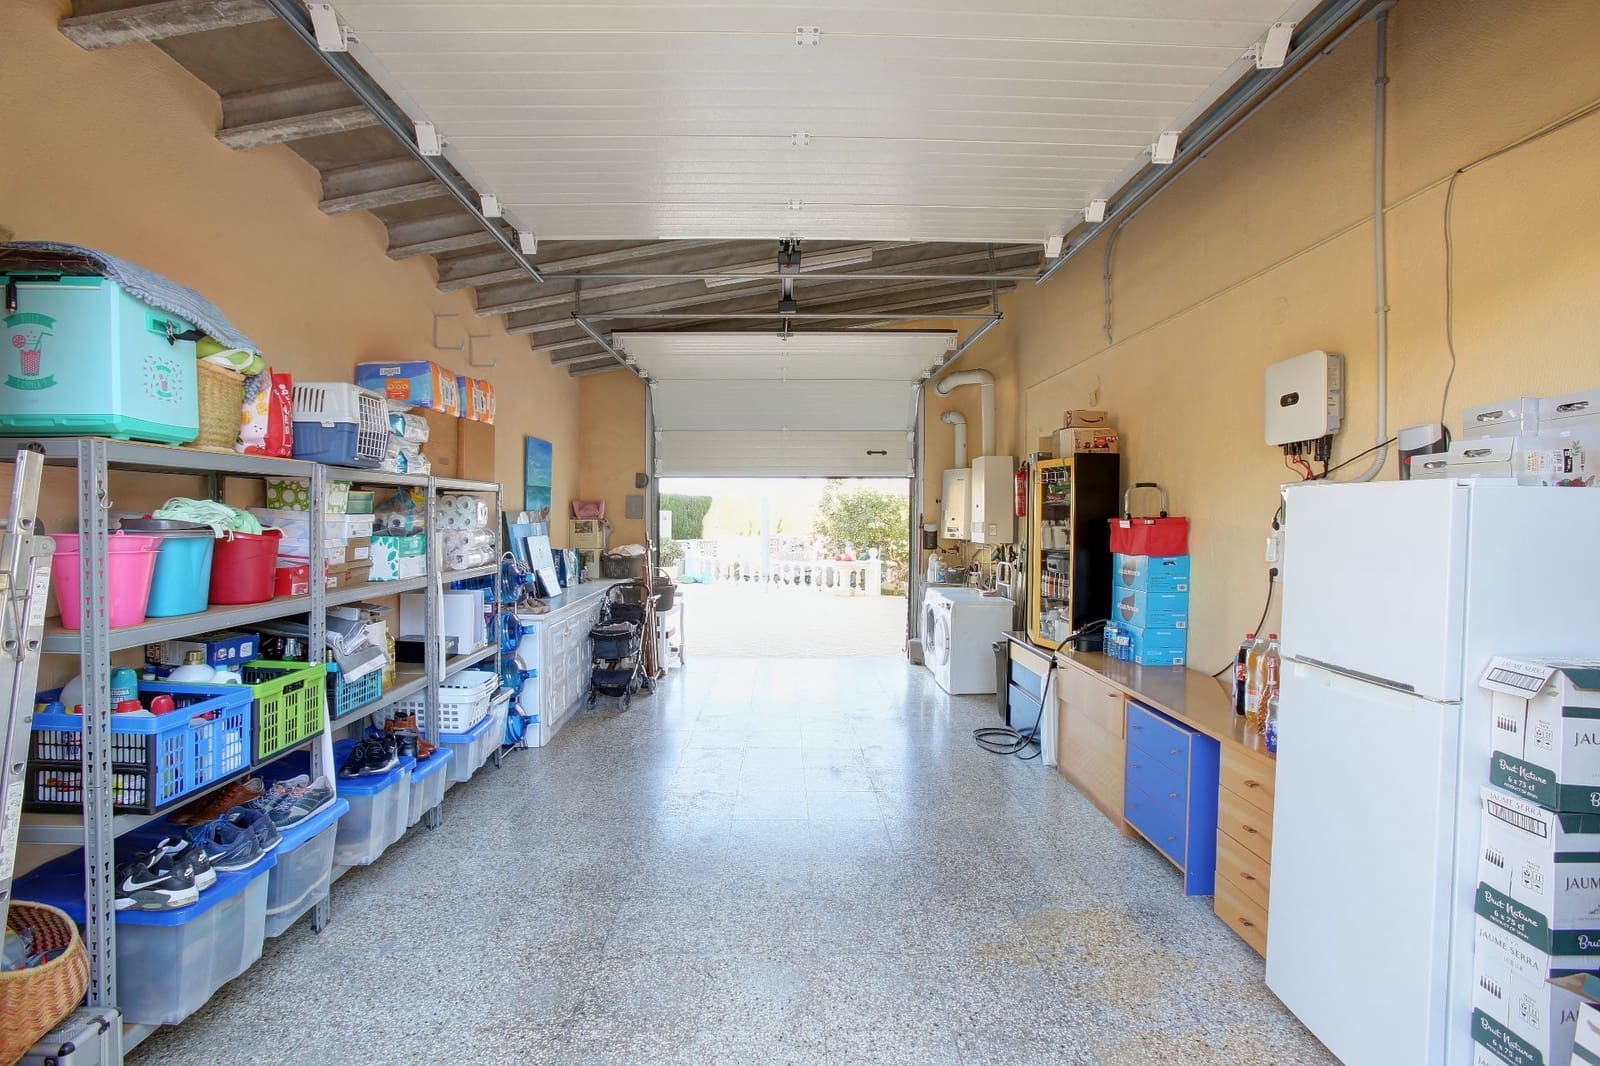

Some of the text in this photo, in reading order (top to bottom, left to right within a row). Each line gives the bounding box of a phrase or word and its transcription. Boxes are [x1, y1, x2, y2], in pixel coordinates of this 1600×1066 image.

[1498, 758, 1548, 785] Brut Nature
[1518, 780, 1527, 789] 75
[1490, 792, 1542, 817] JAUME SERRA
[1484, 890, 1539, 928] Brut Nature
[1506, 916, 1516, 926] 75
[1479, 928, 1506, 950] JAUME
[1510, 948, 1539, 972] SERRA
[1480, 1016, 1502, 1038] Brut
[1503, 1032, 1534, 1061] Nature
